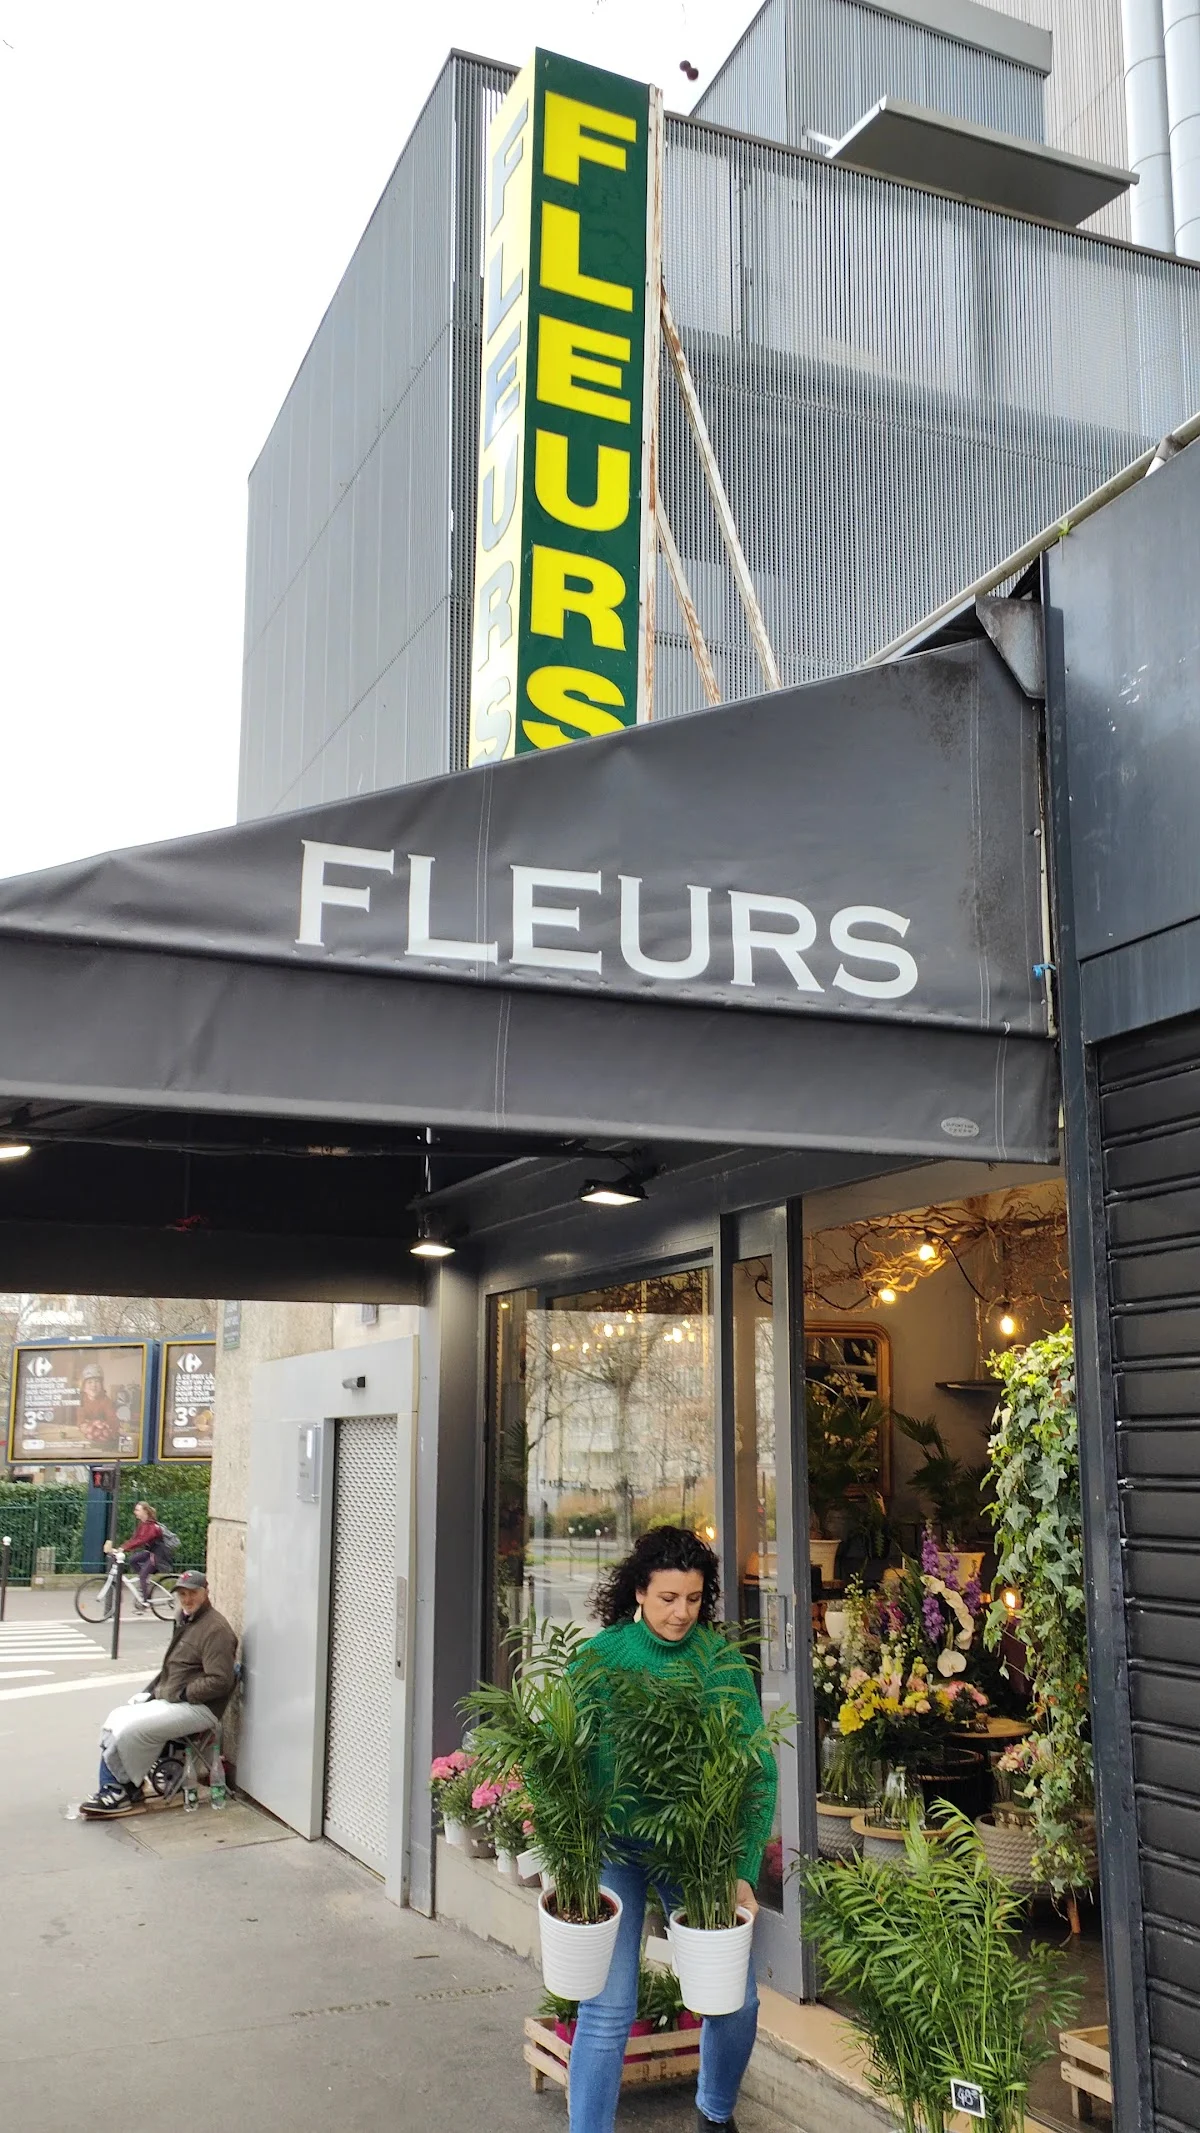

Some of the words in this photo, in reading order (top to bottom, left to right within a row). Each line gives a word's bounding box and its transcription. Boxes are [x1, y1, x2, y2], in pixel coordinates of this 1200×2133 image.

[472, 98, 528, 767] FLEURS
[522, 89, 637, 750] FLEURS
[295, 839, 919, 999] FLEURS
